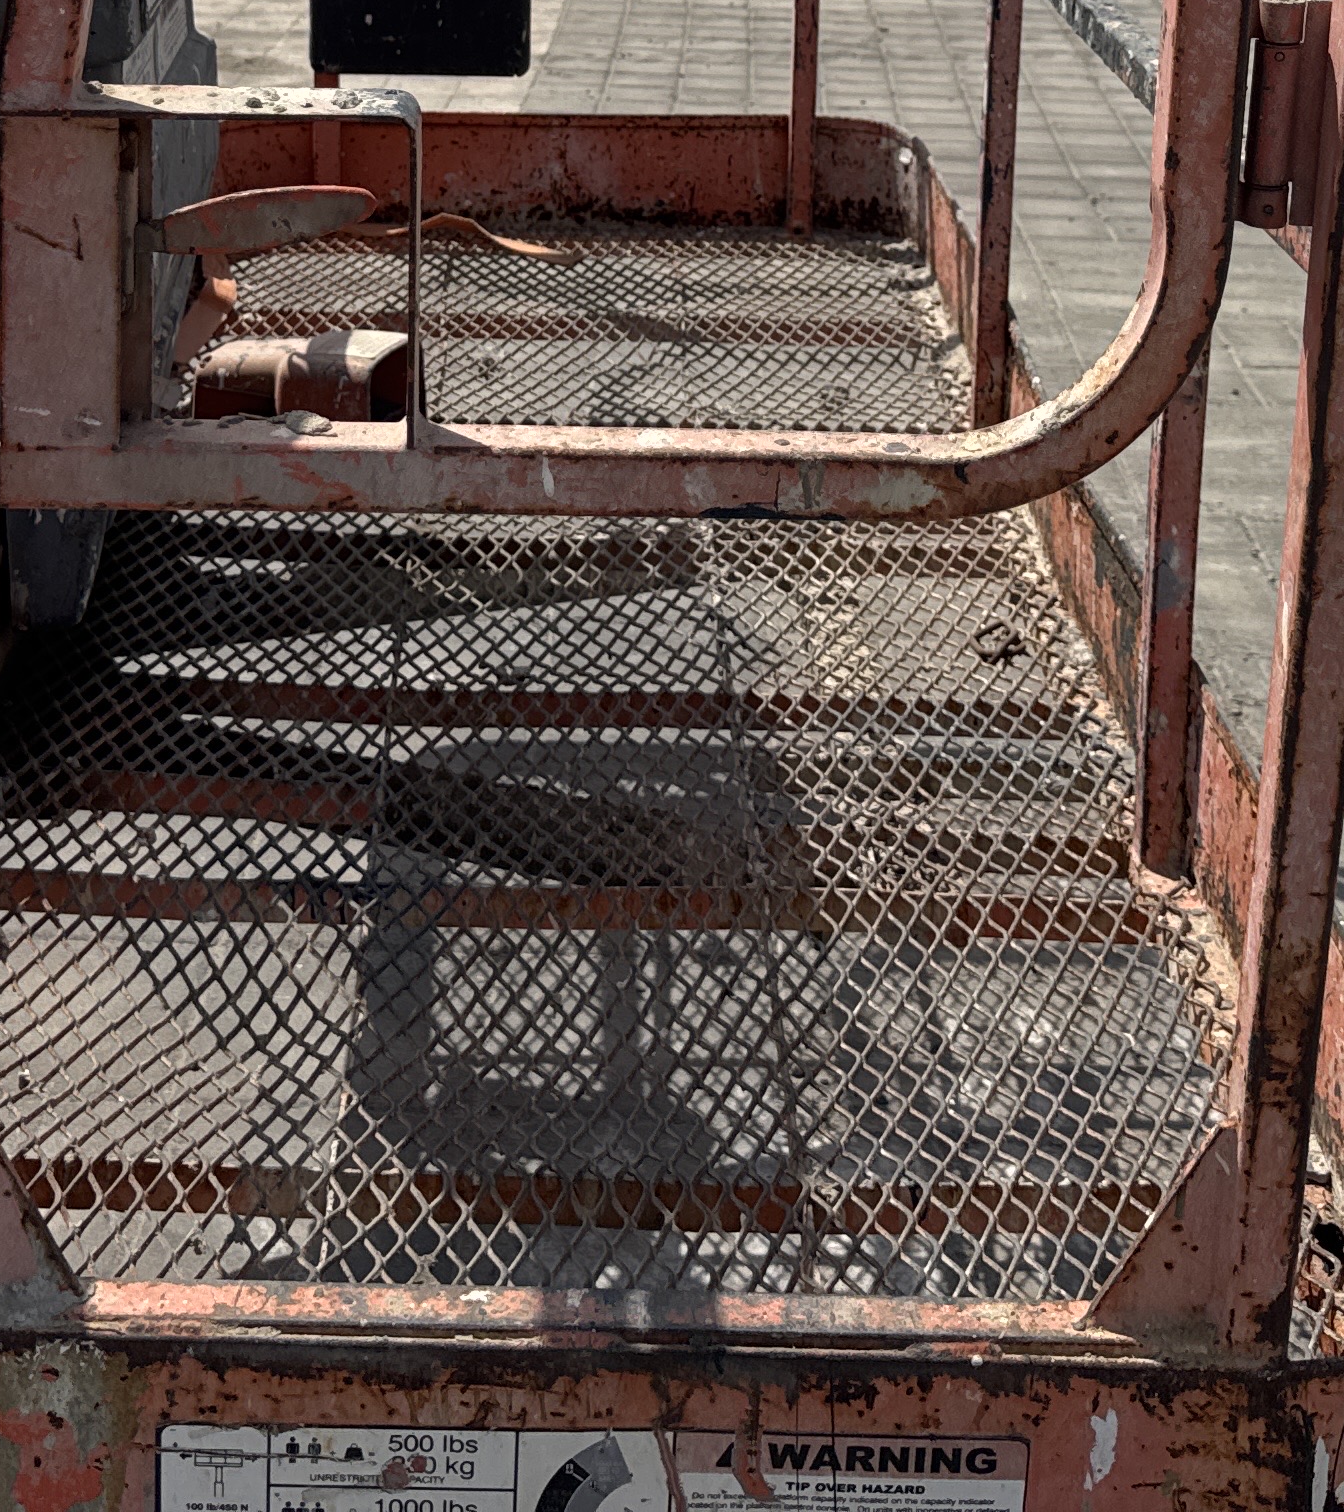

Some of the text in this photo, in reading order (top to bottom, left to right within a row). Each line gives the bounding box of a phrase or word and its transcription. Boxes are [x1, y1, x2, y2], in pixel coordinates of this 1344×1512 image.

[388, 1434, 479, 1454] 500 lbs
[768, 1443, 997, 1474] WARNING
[446, 1455, 475, 1480] kg
[310, 1473, 445, 1485] UNRESTRICT PACITY
[785, 1482, 926, 1495] TIP OVER HAZARD
[375, 1499, 434, 1512] 1000
[691, 1492, 705, 1500] Do
[707, 1492, 721, 1500] not
[811, 1496, 847, 1504] capacity
[849, 1496, 889, 1504] indicated
[904, 1497, 918, 1505] the
[920, 1498, 956, 1507] capacity
[186, 1502, 204, 1510] 100
[241, 1503, 248, 1512] N
